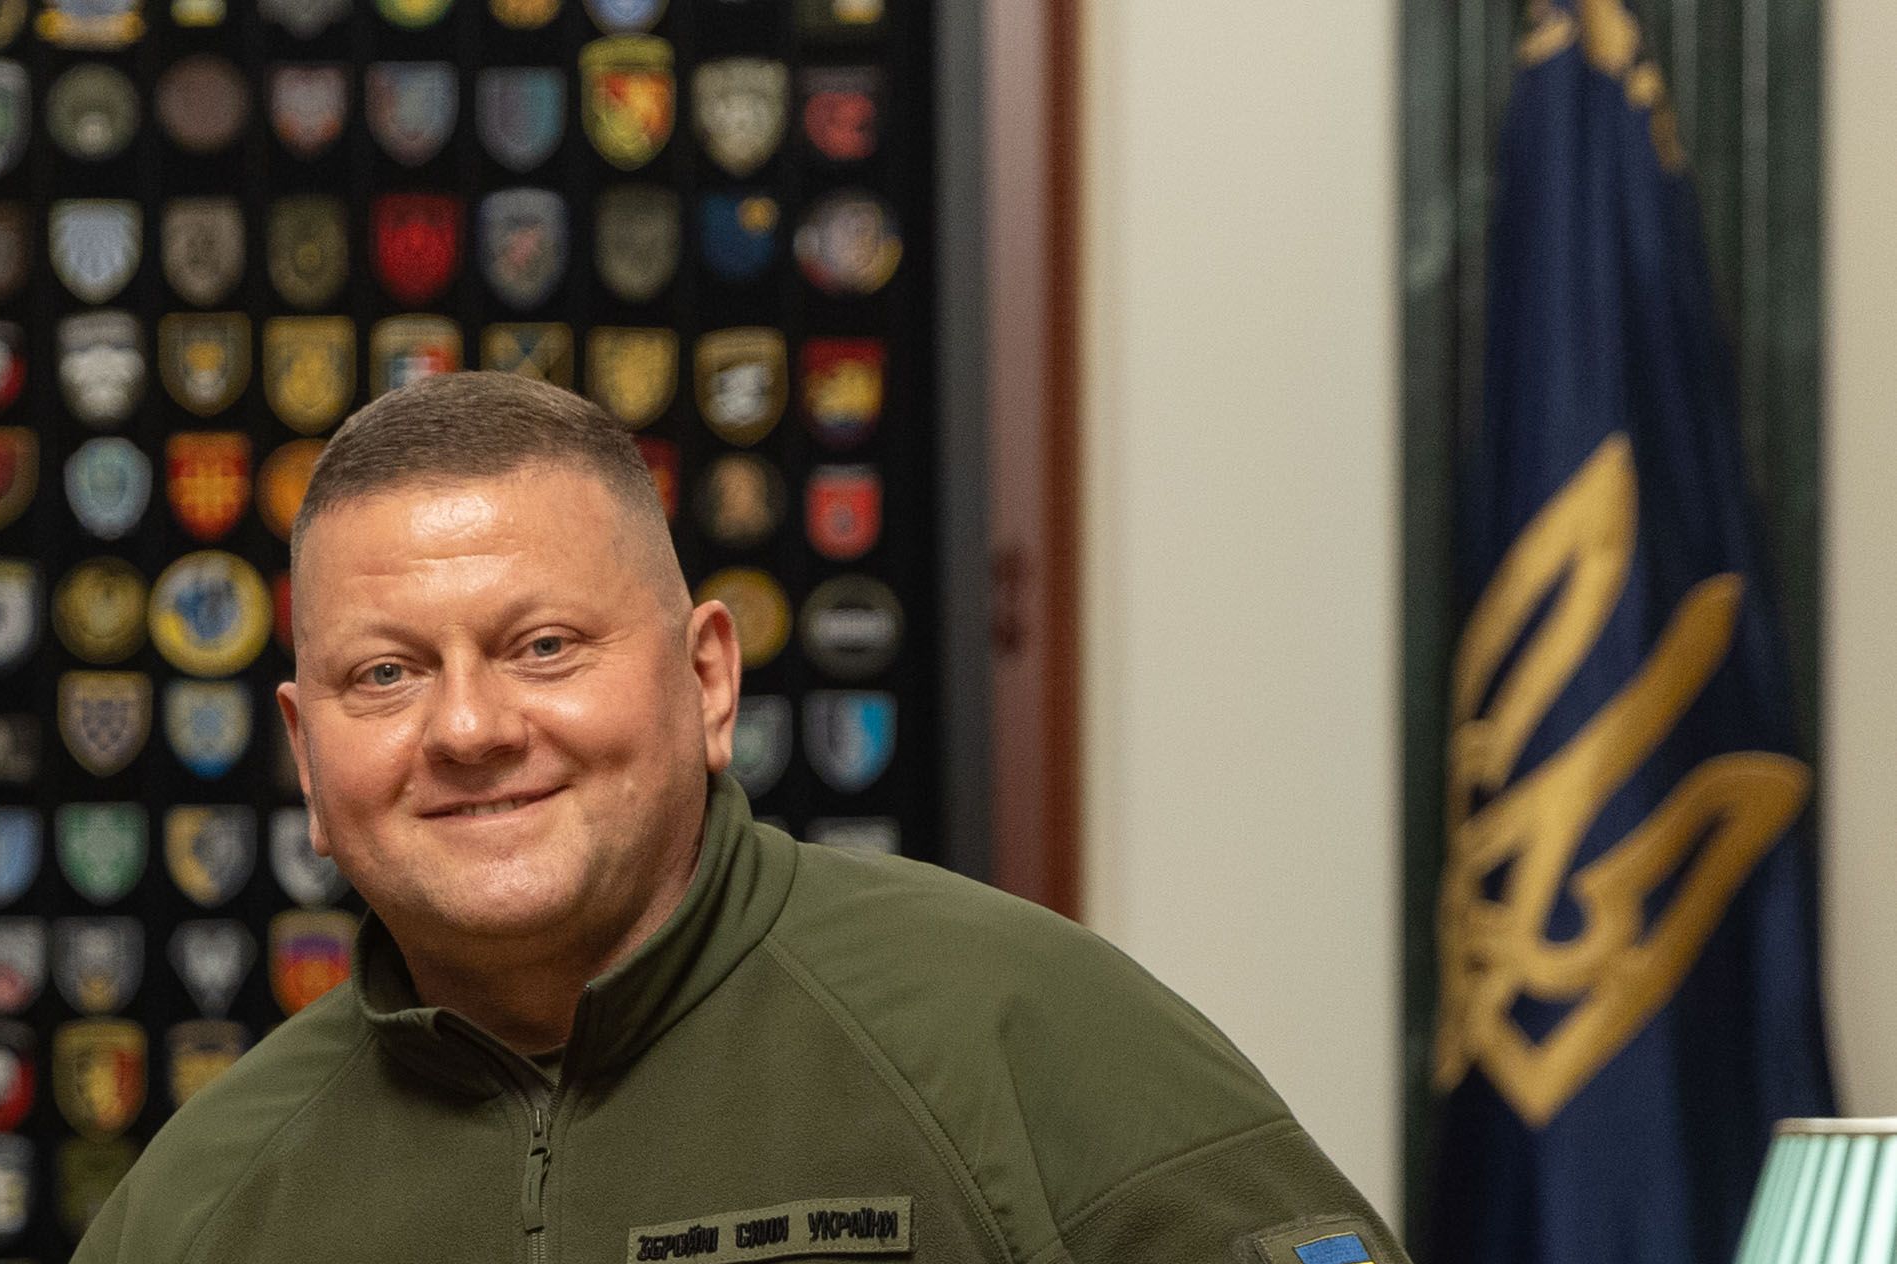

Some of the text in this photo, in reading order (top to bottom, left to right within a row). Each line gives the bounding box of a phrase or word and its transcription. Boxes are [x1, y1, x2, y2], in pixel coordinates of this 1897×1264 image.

[636, 1207, 899, 1262] ЗБРОЙНІ СИЛИ УКРАЇНИ
